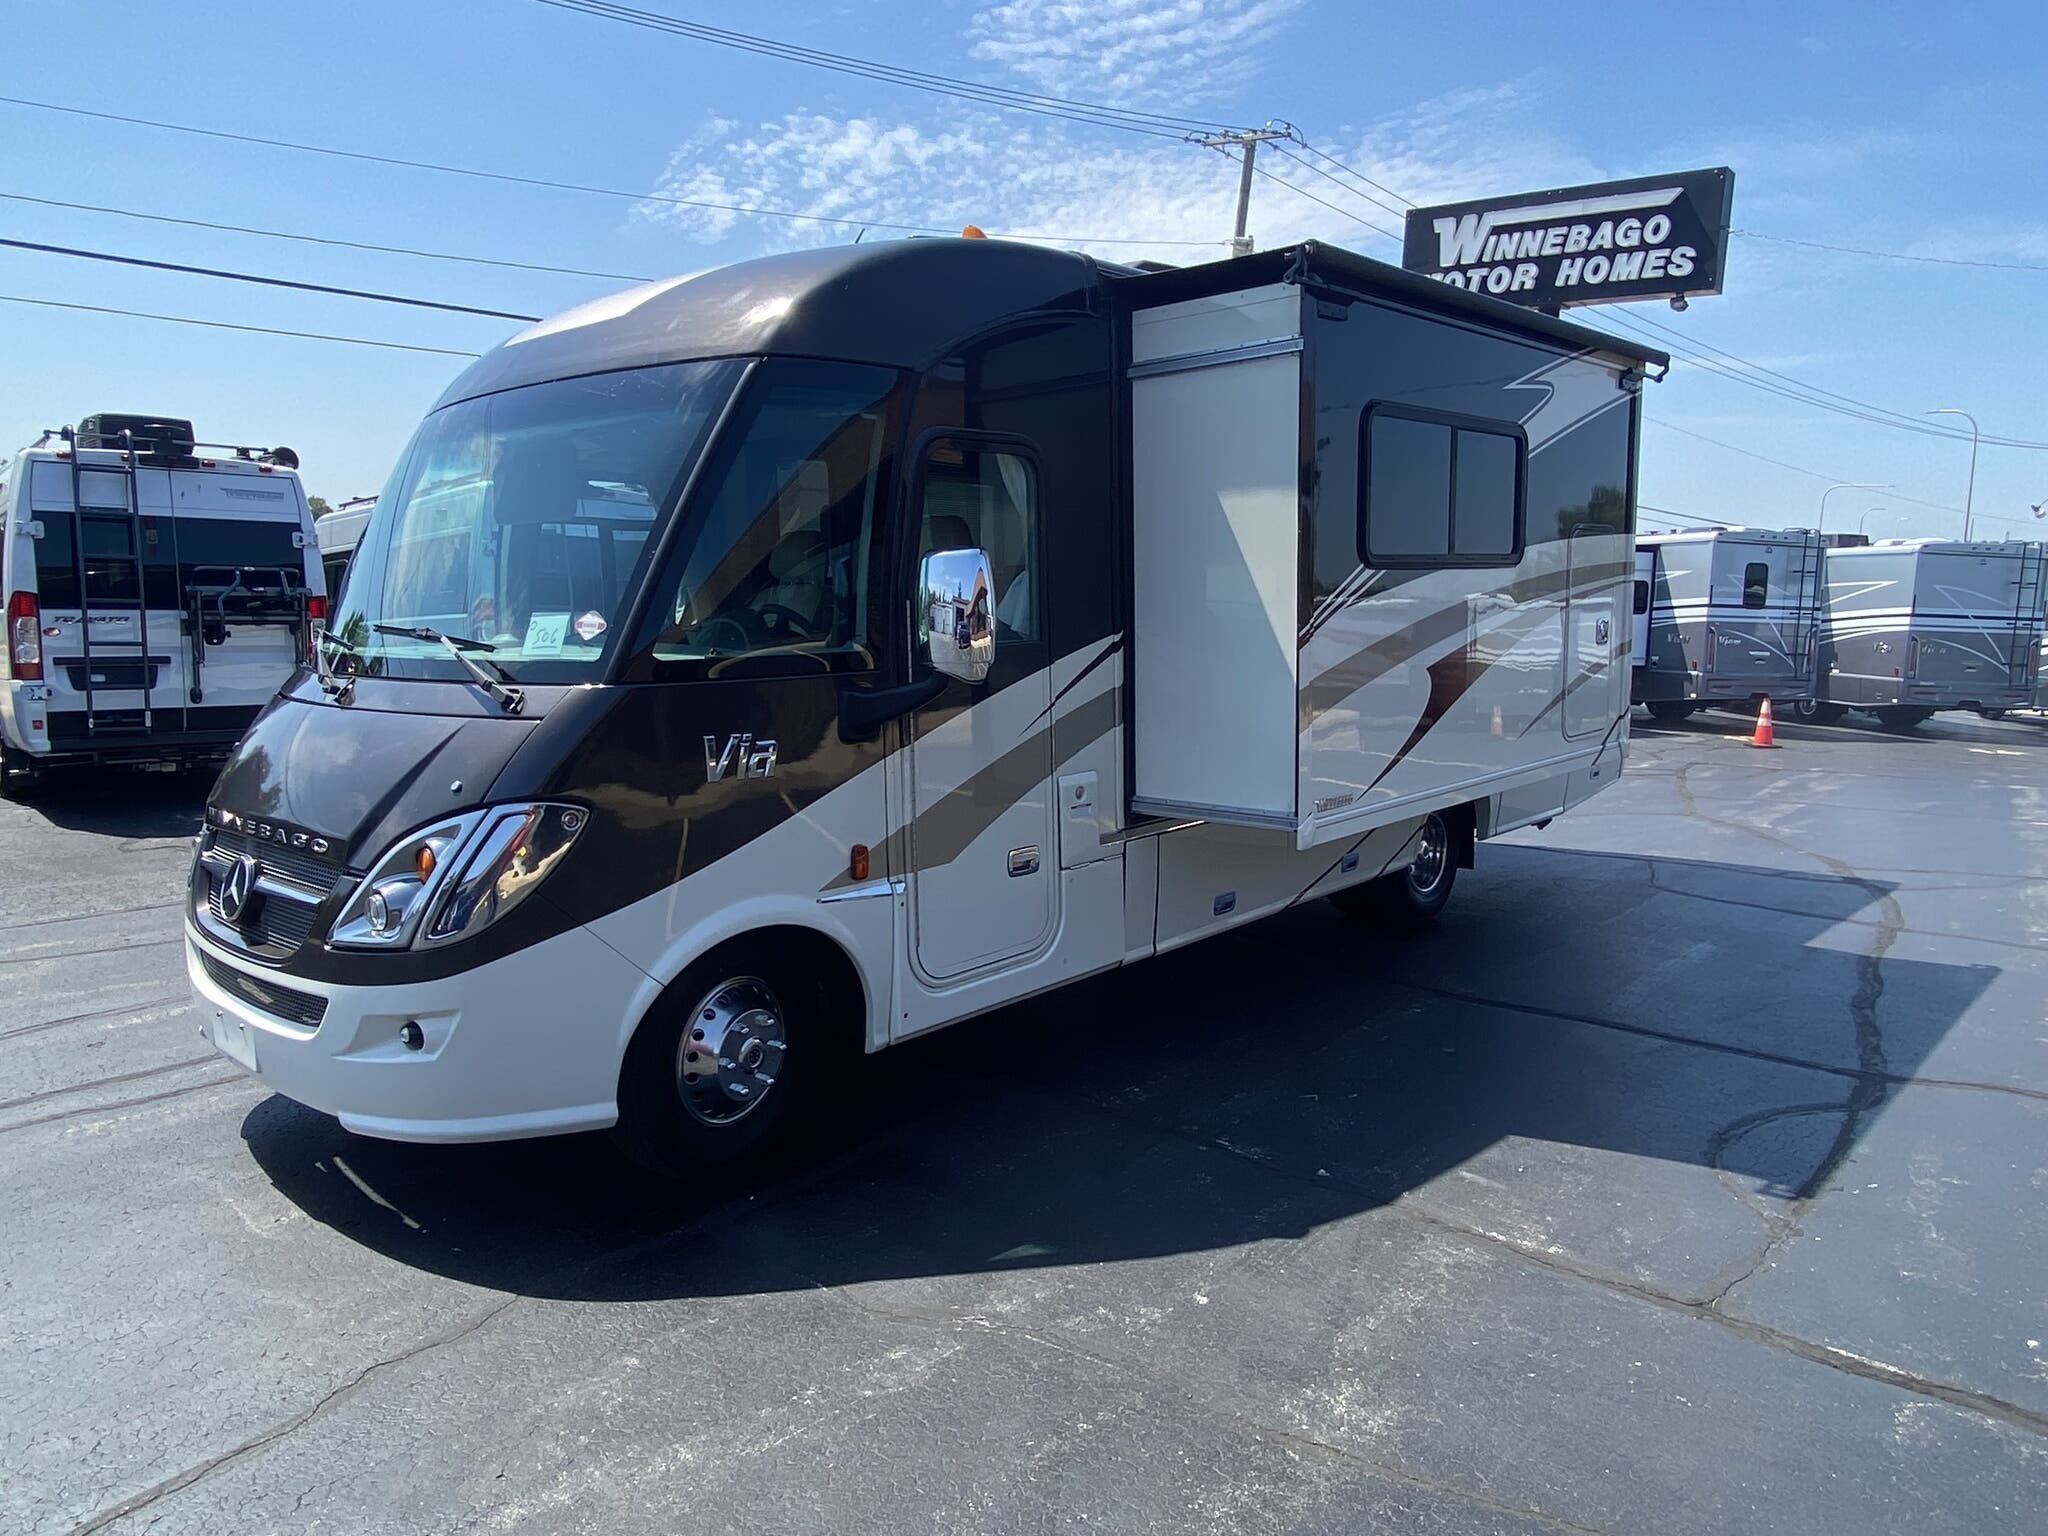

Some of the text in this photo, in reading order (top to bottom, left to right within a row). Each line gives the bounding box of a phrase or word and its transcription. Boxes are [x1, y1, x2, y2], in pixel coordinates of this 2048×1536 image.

[1433, 205, 1674, 267] WINNEBAGO
[1424, 246, 1698, 294] OTOR HOMES
[703, 732, 778, 784] Via
